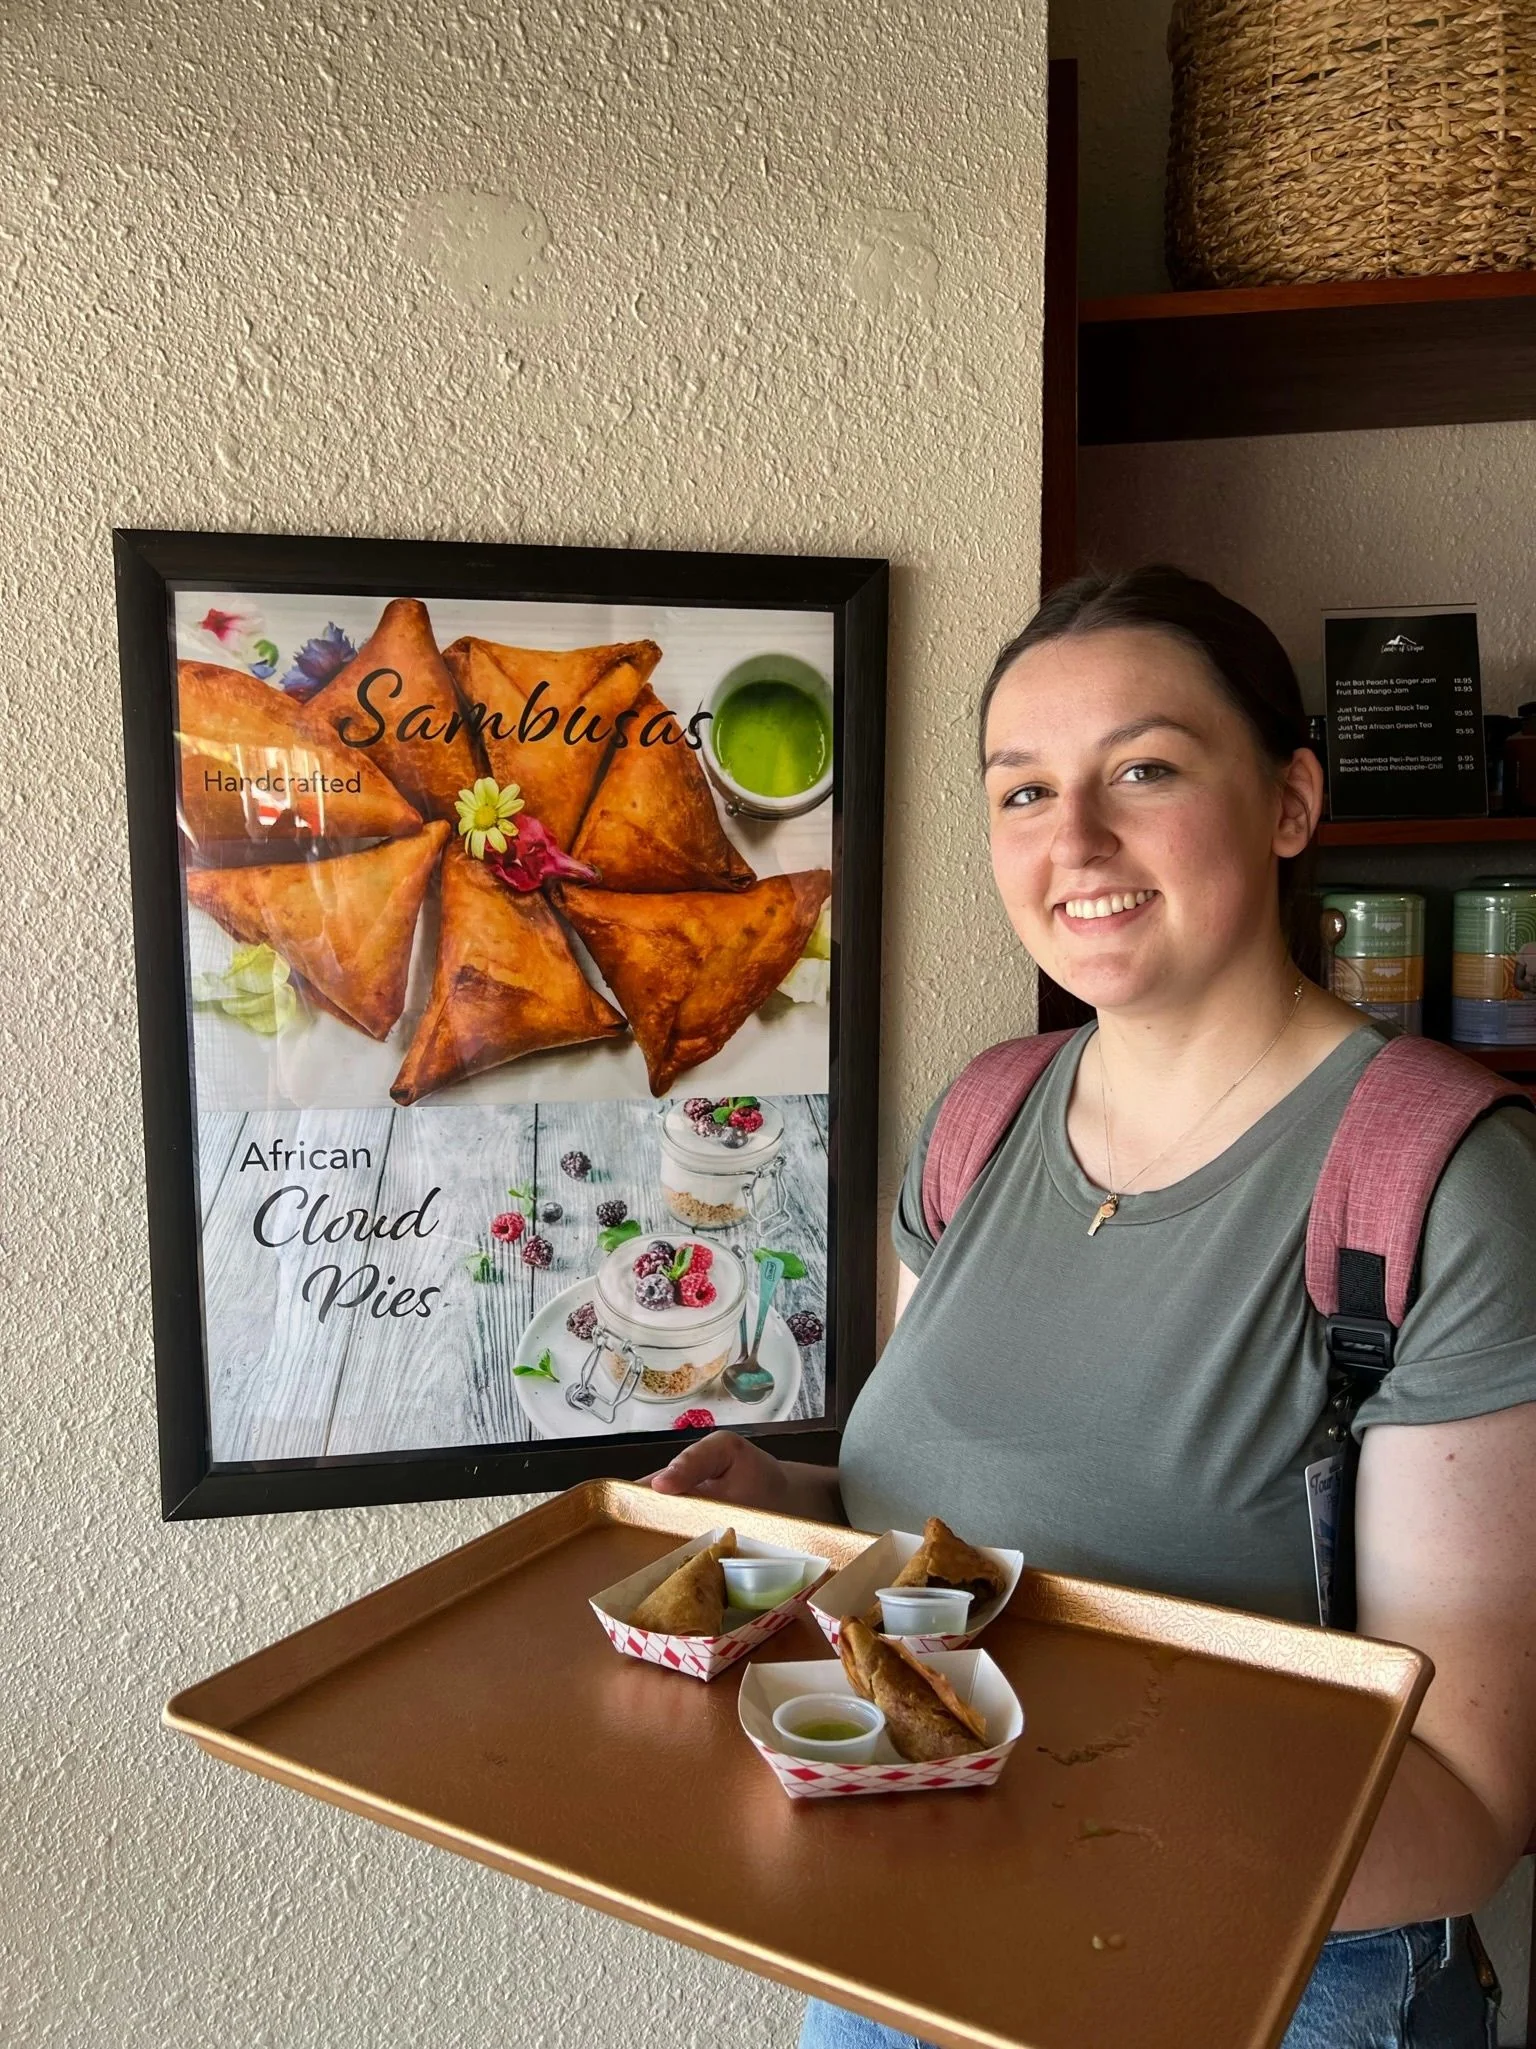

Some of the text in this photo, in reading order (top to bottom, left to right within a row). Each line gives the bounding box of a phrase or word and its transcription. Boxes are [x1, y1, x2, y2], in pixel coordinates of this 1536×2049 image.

[1366, 688, 1392, 696] Mango
[1395, 678, 1419, 686] Ginger
[338, 668, 713, 749] Sambusas
[1395, 704, 1414, 712] Black
[1354, 723, 1368, 731] Tea
[203, 769, 362, 795] Handcrafted
[239, 1138, 372, 1172] African
[252, 1185, 442, 1249] Cloud
[301, 1263, 442, 1323] Pies
